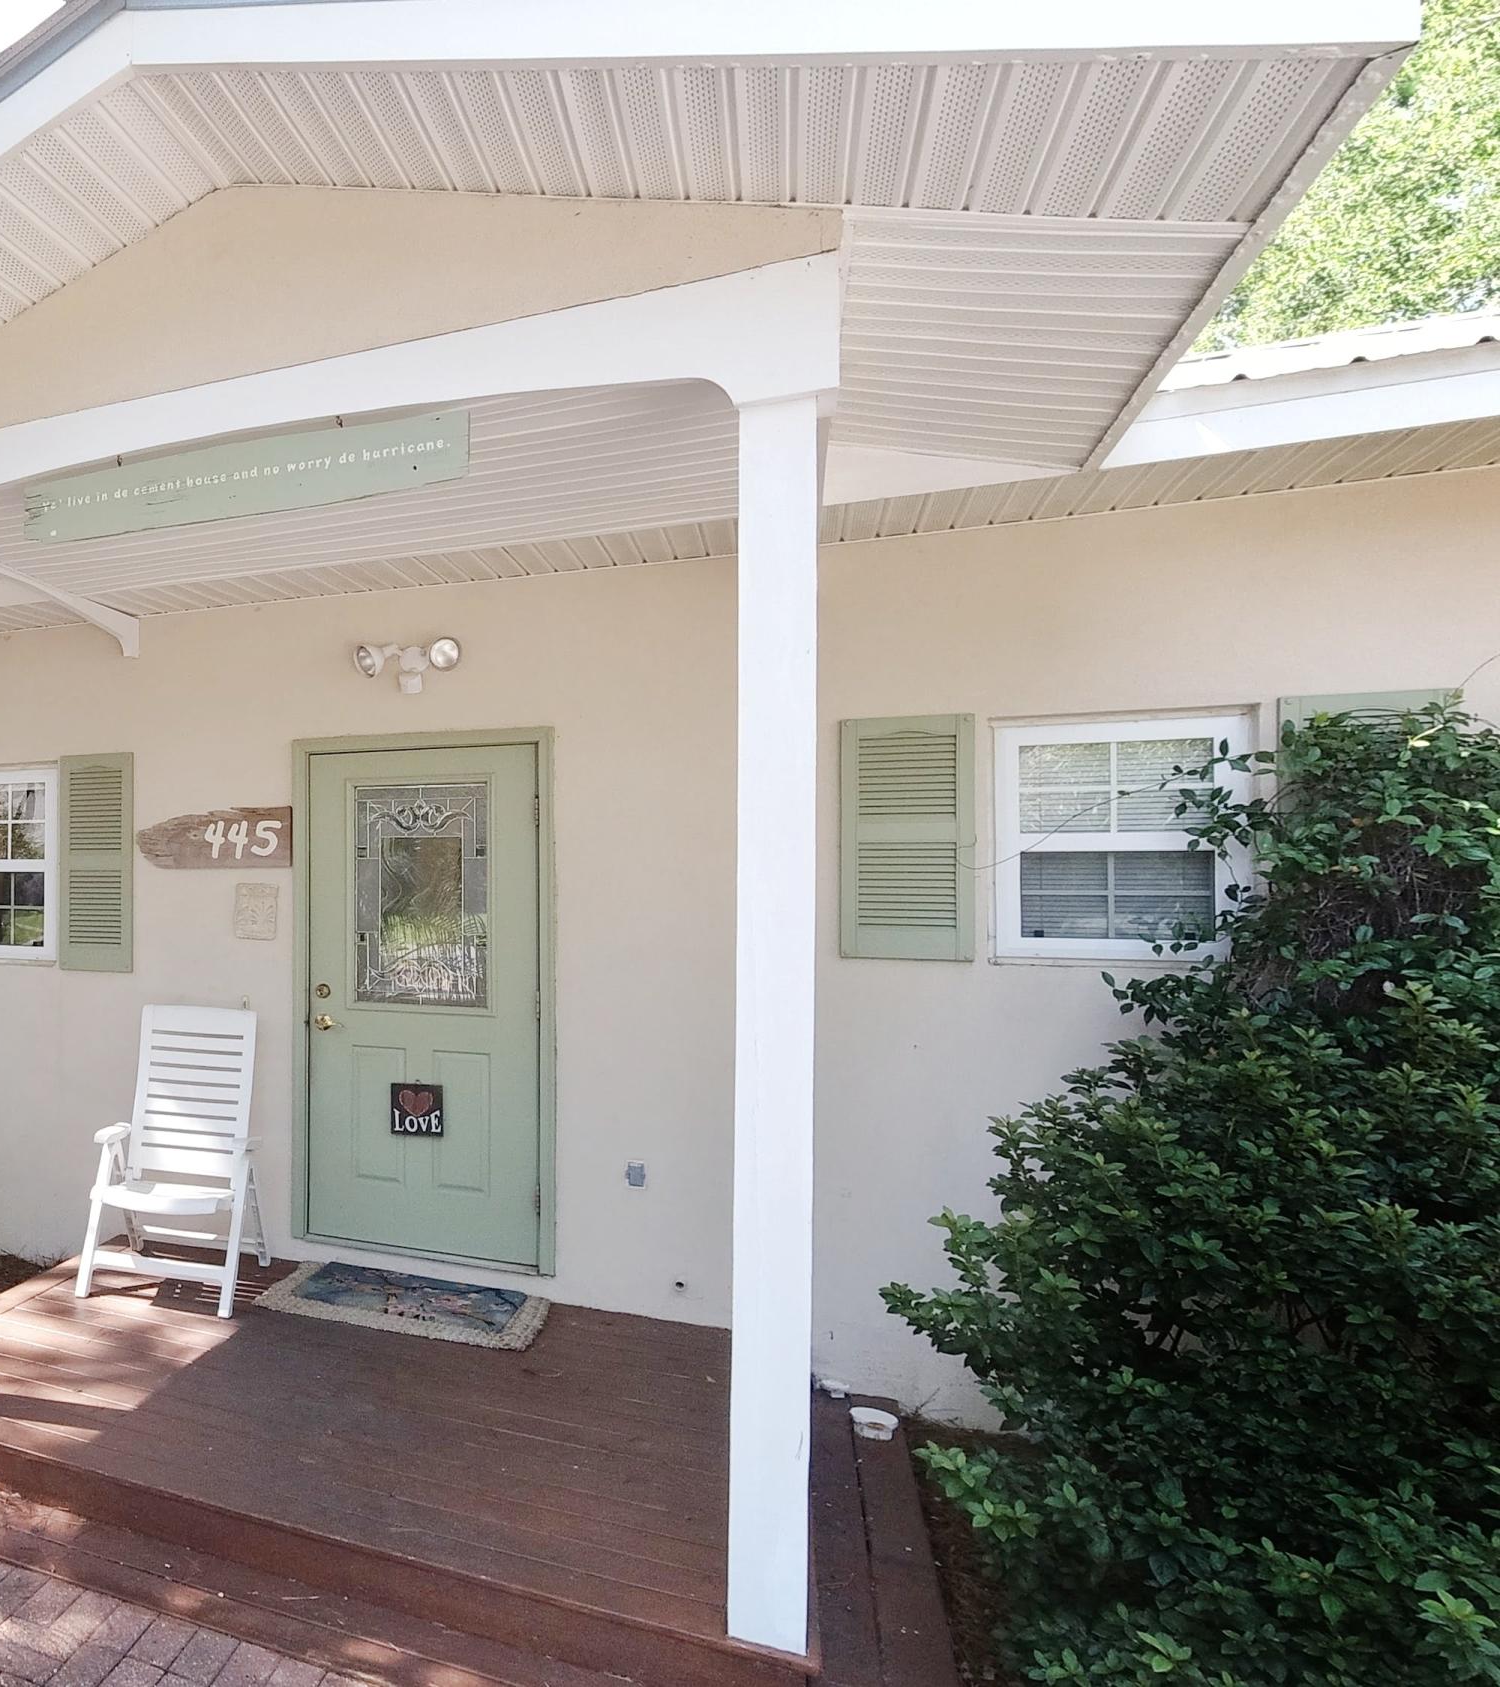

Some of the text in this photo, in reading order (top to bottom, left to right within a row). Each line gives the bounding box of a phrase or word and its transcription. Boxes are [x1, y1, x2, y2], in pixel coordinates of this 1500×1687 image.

[67, 495, 92, 508] live
[96, 490, 109, 503] in
[113, 487, 129, 499] de
[186, 474, 227, 487] house
[233, 466, 258, 480] and
[263, 465, 281, 477] no
[287, 456, 331, 473] worry
[339, 452, 356, 464] de
[363, 439, 451, 461] hurricane.
[204, 820, 282, 860] 445
[393, 1108, 442, 1133] LOVE
